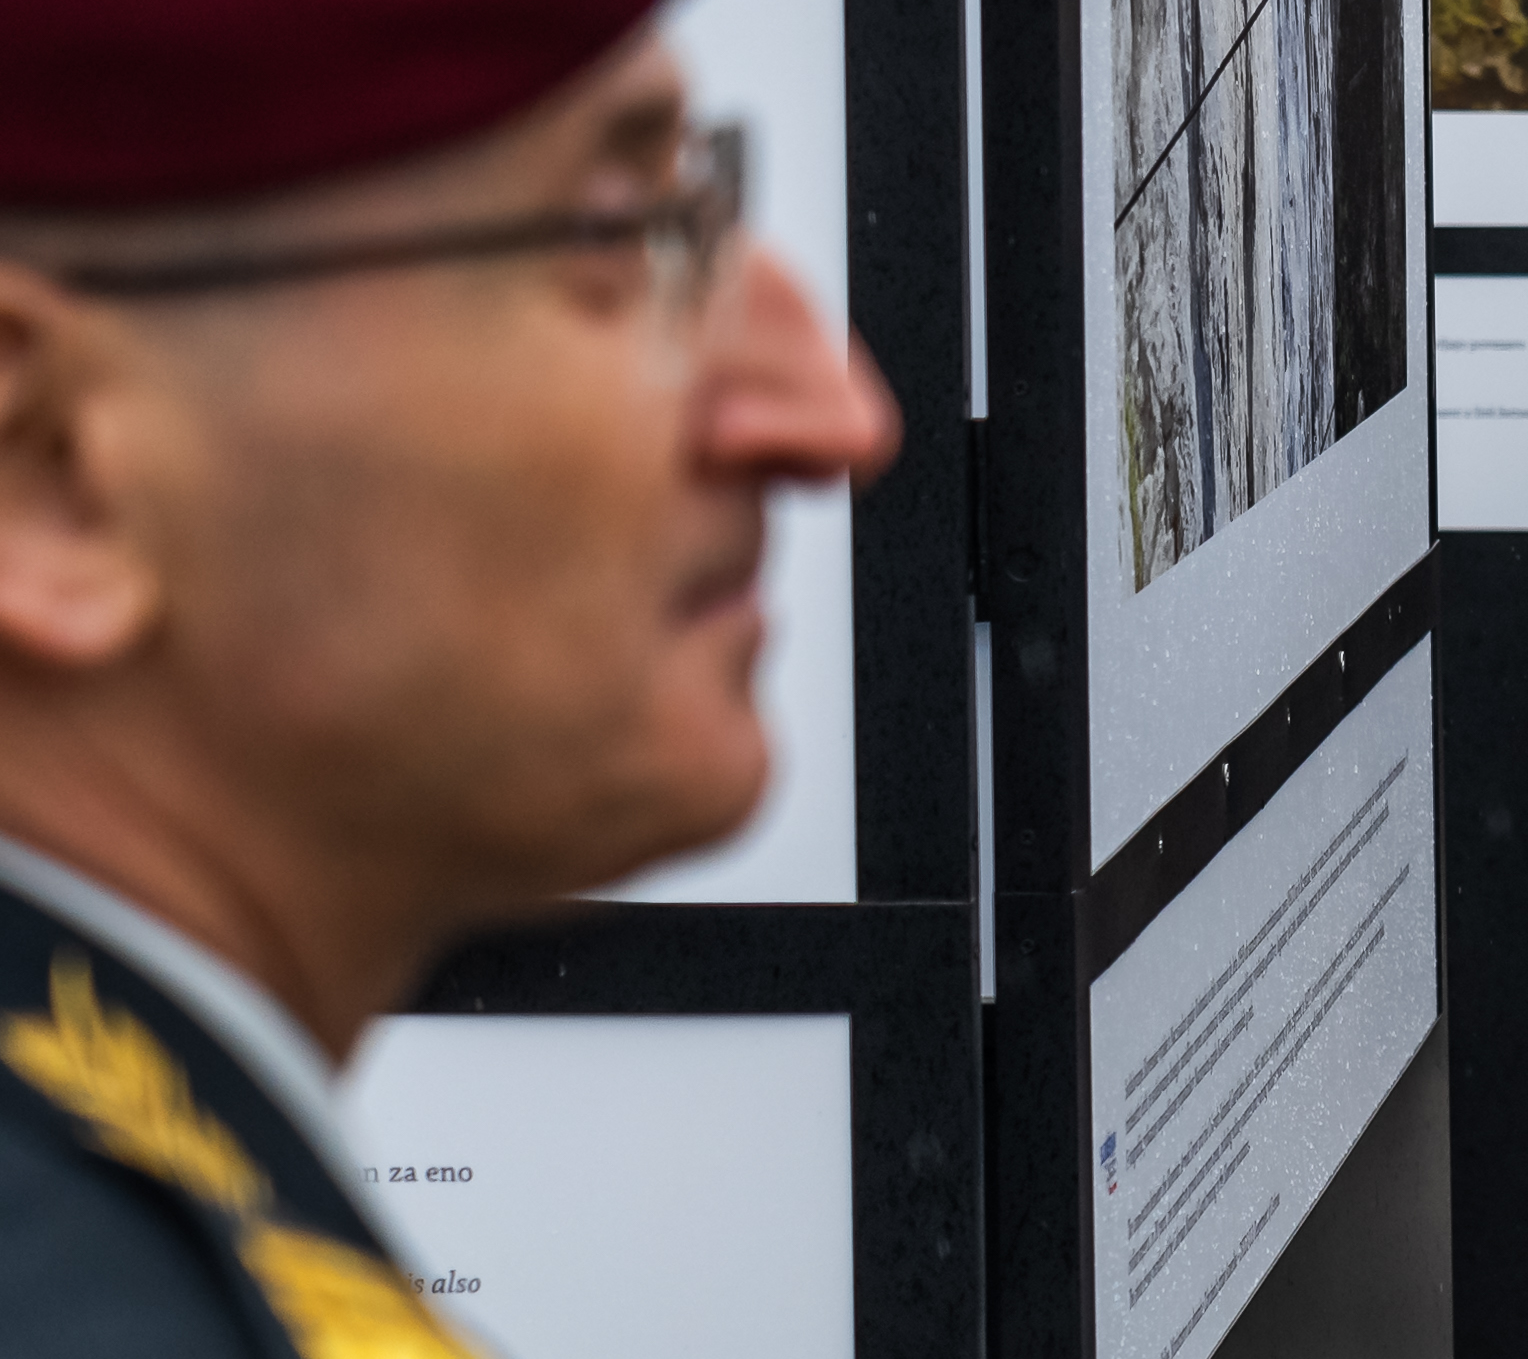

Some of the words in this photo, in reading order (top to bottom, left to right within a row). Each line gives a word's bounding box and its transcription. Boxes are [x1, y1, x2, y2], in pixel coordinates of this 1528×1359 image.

[388, 1166, 418, 1183] za
[425, 1166, 474, 1183] eno
[431, 1269, 482, 1294] also
